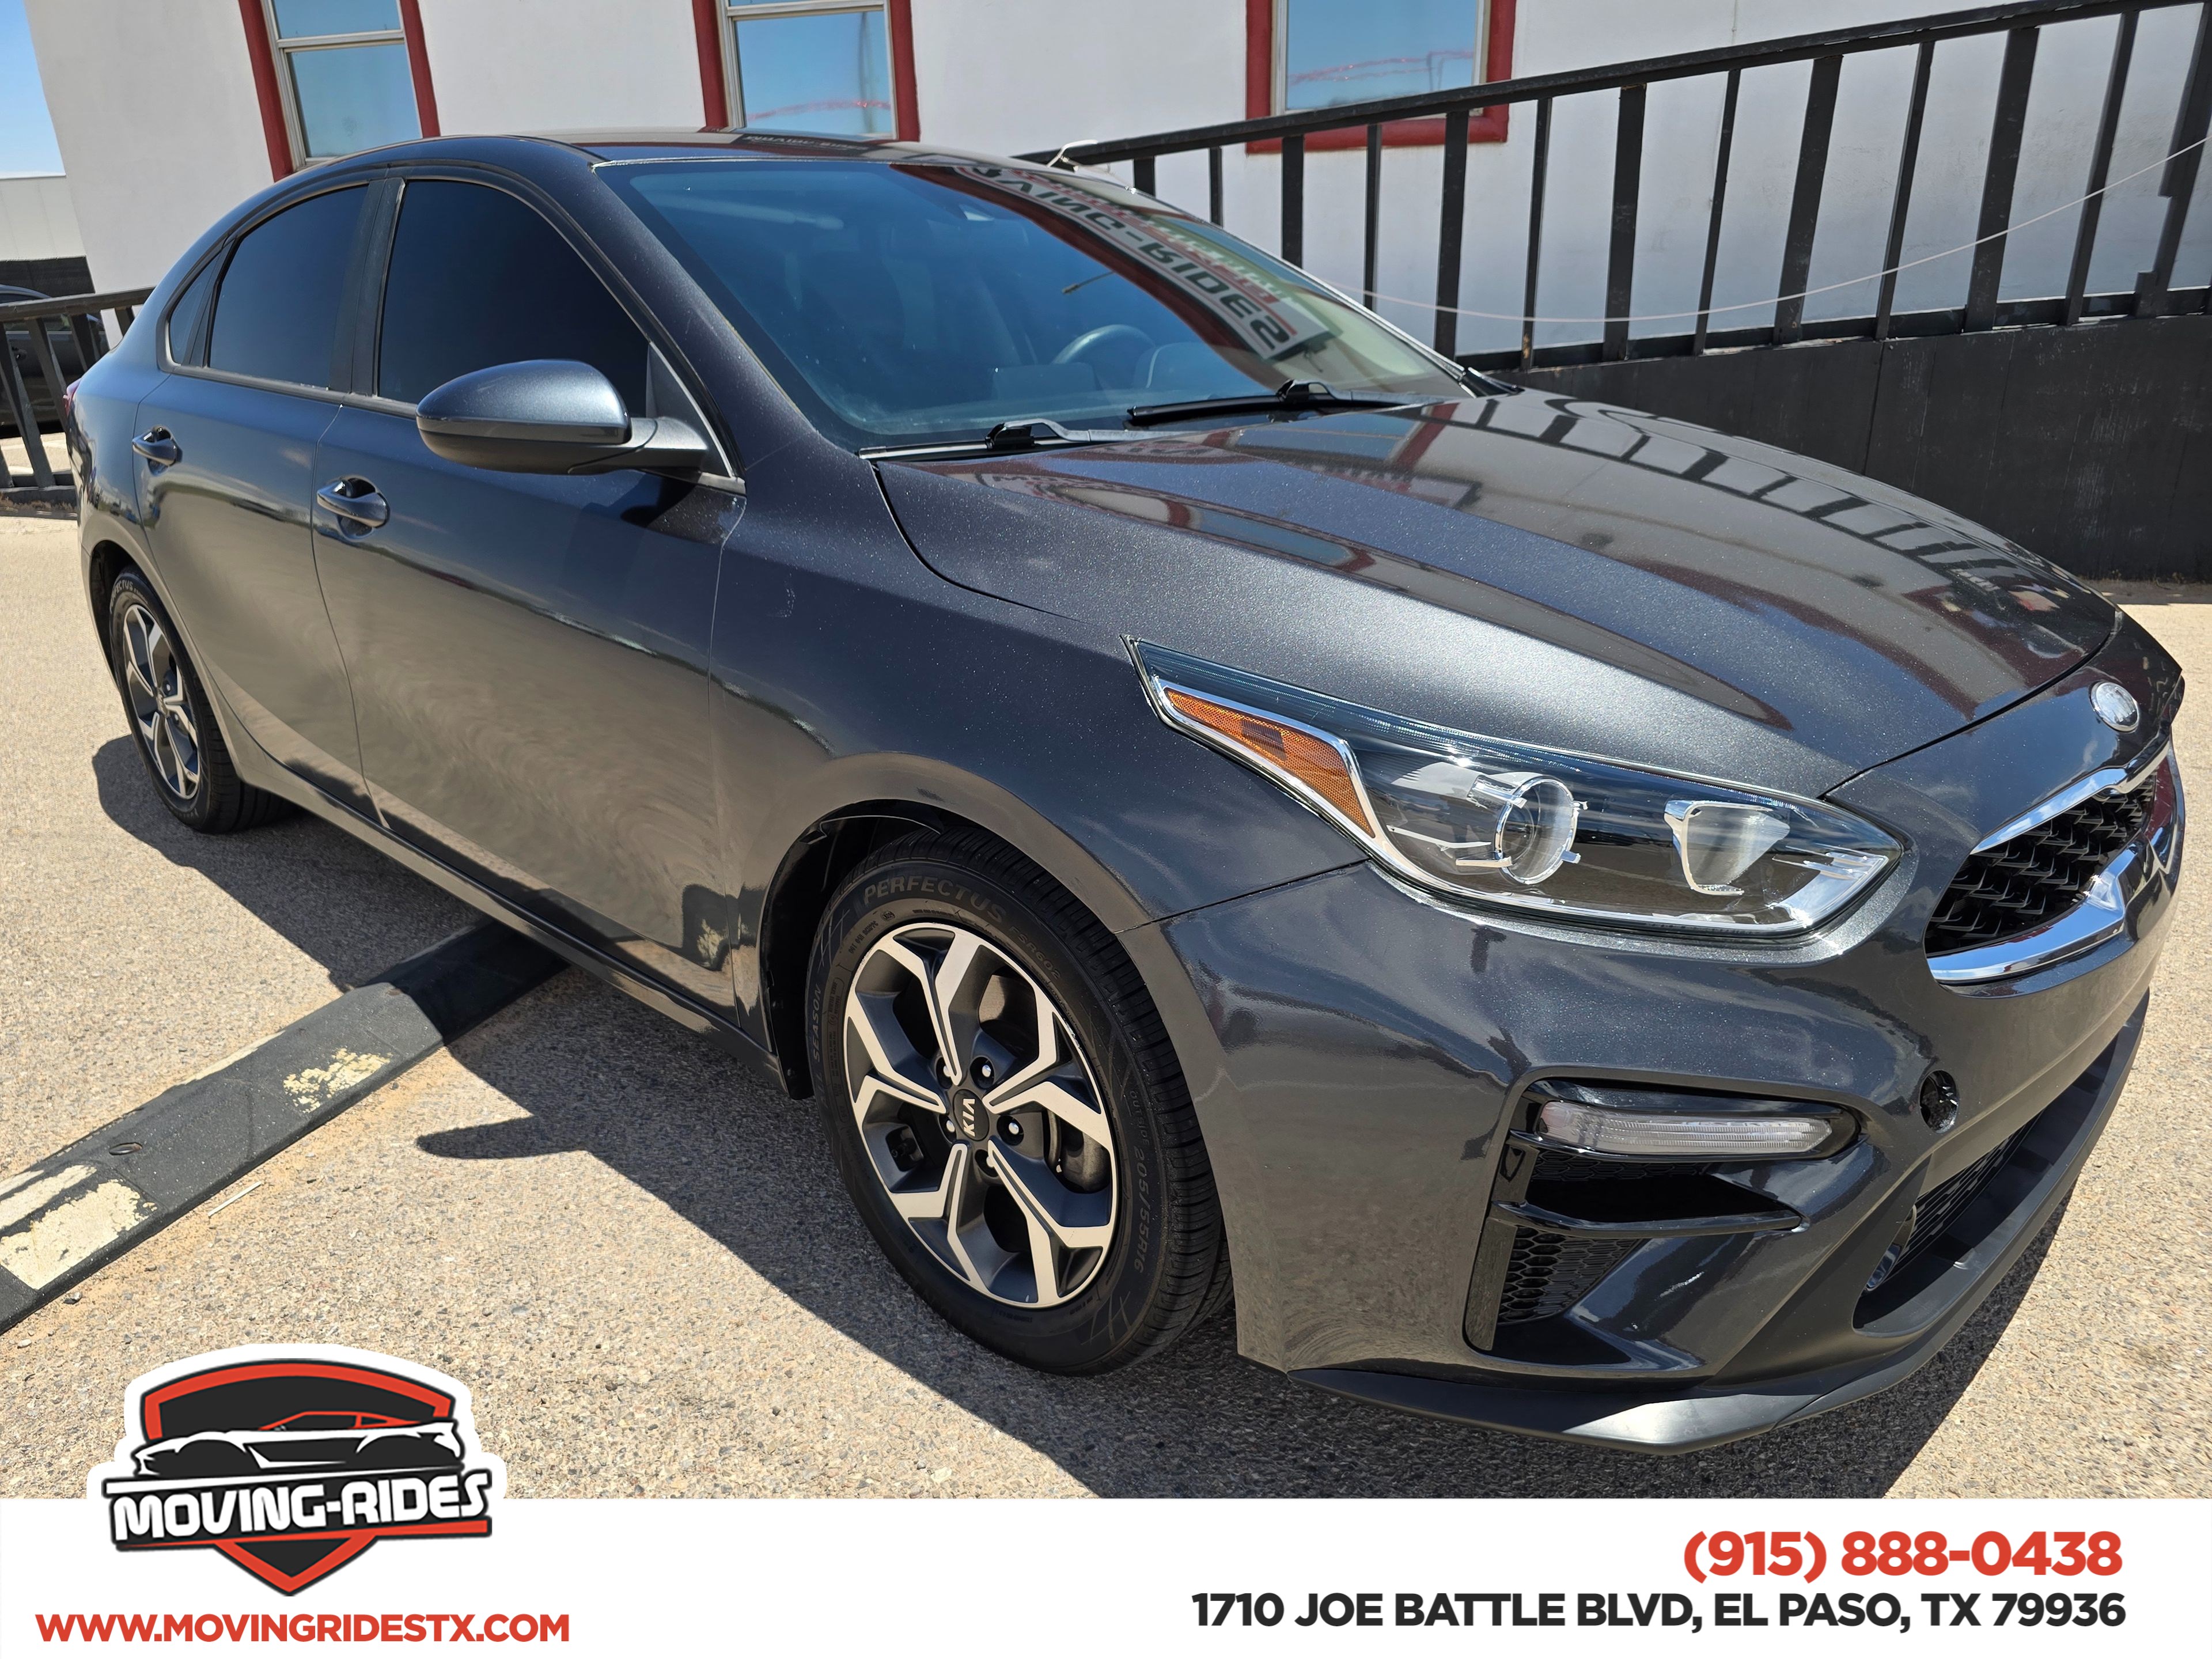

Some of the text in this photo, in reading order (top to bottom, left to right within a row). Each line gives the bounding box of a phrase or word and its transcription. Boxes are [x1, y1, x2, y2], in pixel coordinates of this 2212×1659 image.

[864, 875, 1008, 922] PERFECTUS
[1009, 926, 1061, 979] FSR602
[812, 982, 822, 1063] SEASON
[963, 1099, 976, 1137] KIA
[1129, 1090, 1152, 1273] OUTSIDE 205/55R16
